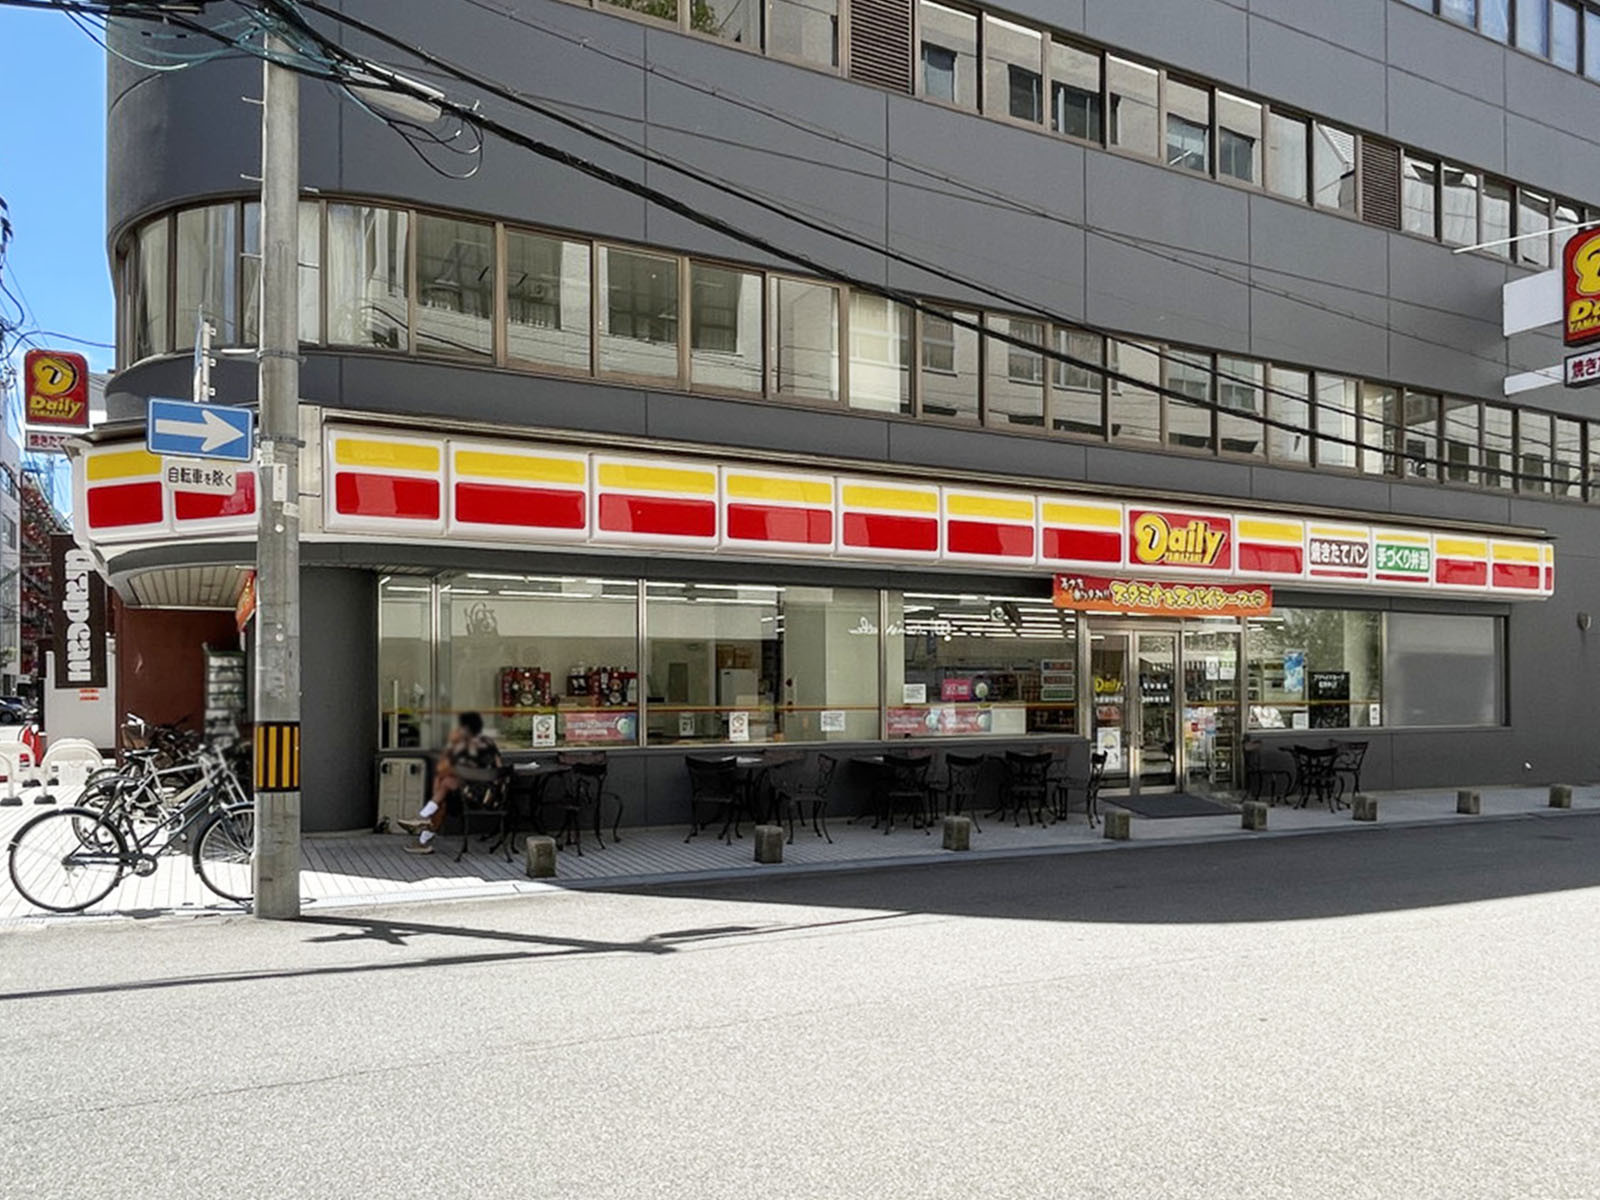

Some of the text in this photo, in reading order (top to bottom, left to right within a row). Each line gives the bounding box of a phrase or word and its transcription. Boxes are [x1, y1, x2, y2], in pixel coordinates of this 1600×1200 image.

[1572, 356, 1600, 379] 焼き
[30, 395, 83, 419] Daily
[168, 466, 232, 487] 自転車を除く
[1134, 512, 1227, 565] Daily
[1310, 540, 1368, 565] 焼きたてパン
[1377, 546, 1428, 571] 手づくり弁当
